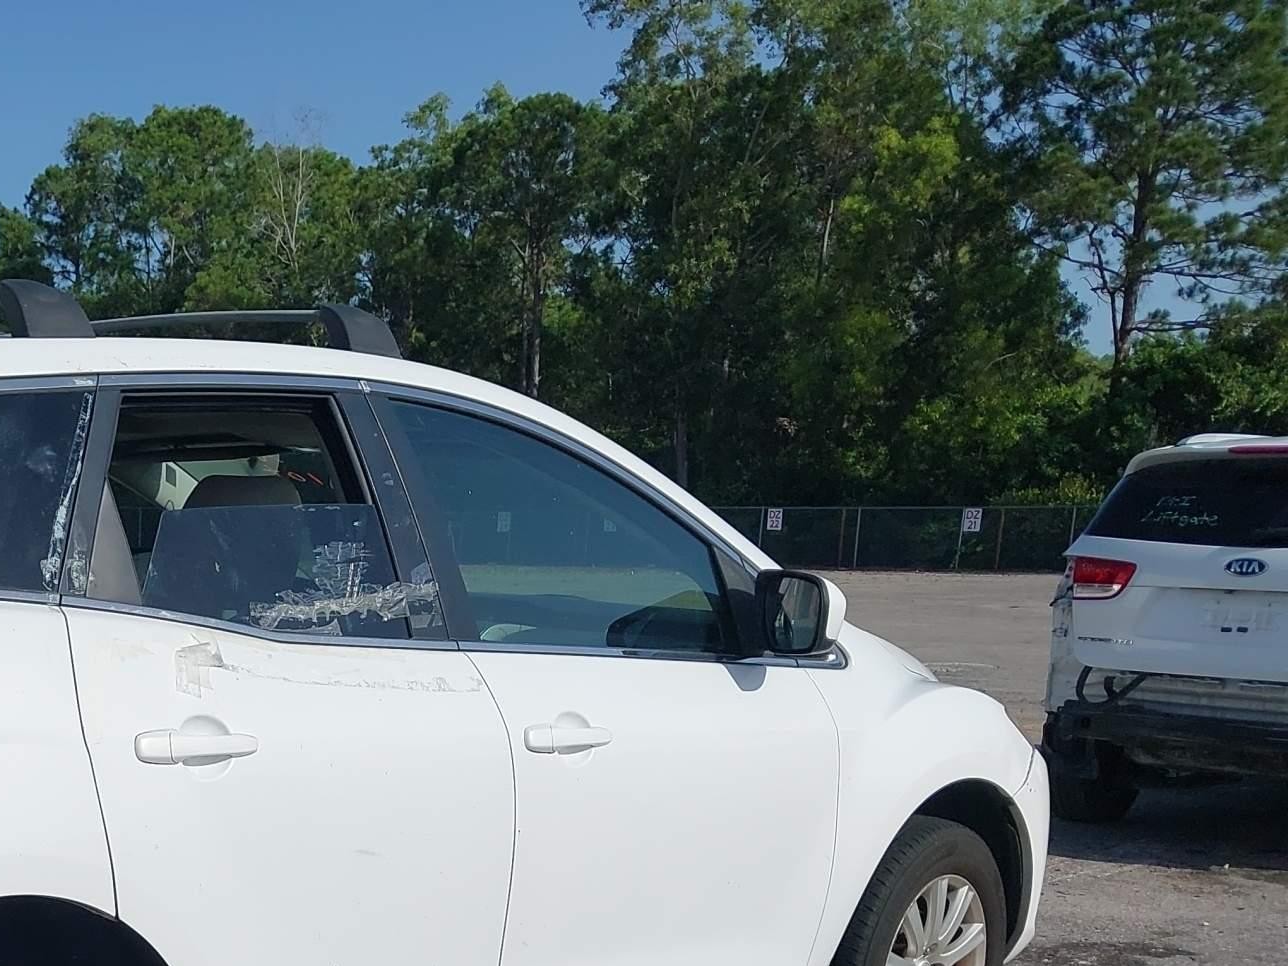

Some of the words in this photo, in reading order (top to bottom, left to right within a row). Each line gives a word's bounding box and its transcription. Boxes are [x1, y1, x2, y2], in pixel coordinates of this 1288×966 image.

[769, 510, 781, 519] DZ
[966, 510, 980, 519] DZ
[769, 519, 780, 528] 22
[967, 520, 977, 529] 21
[1230, 560, 1259, 572] KIA
